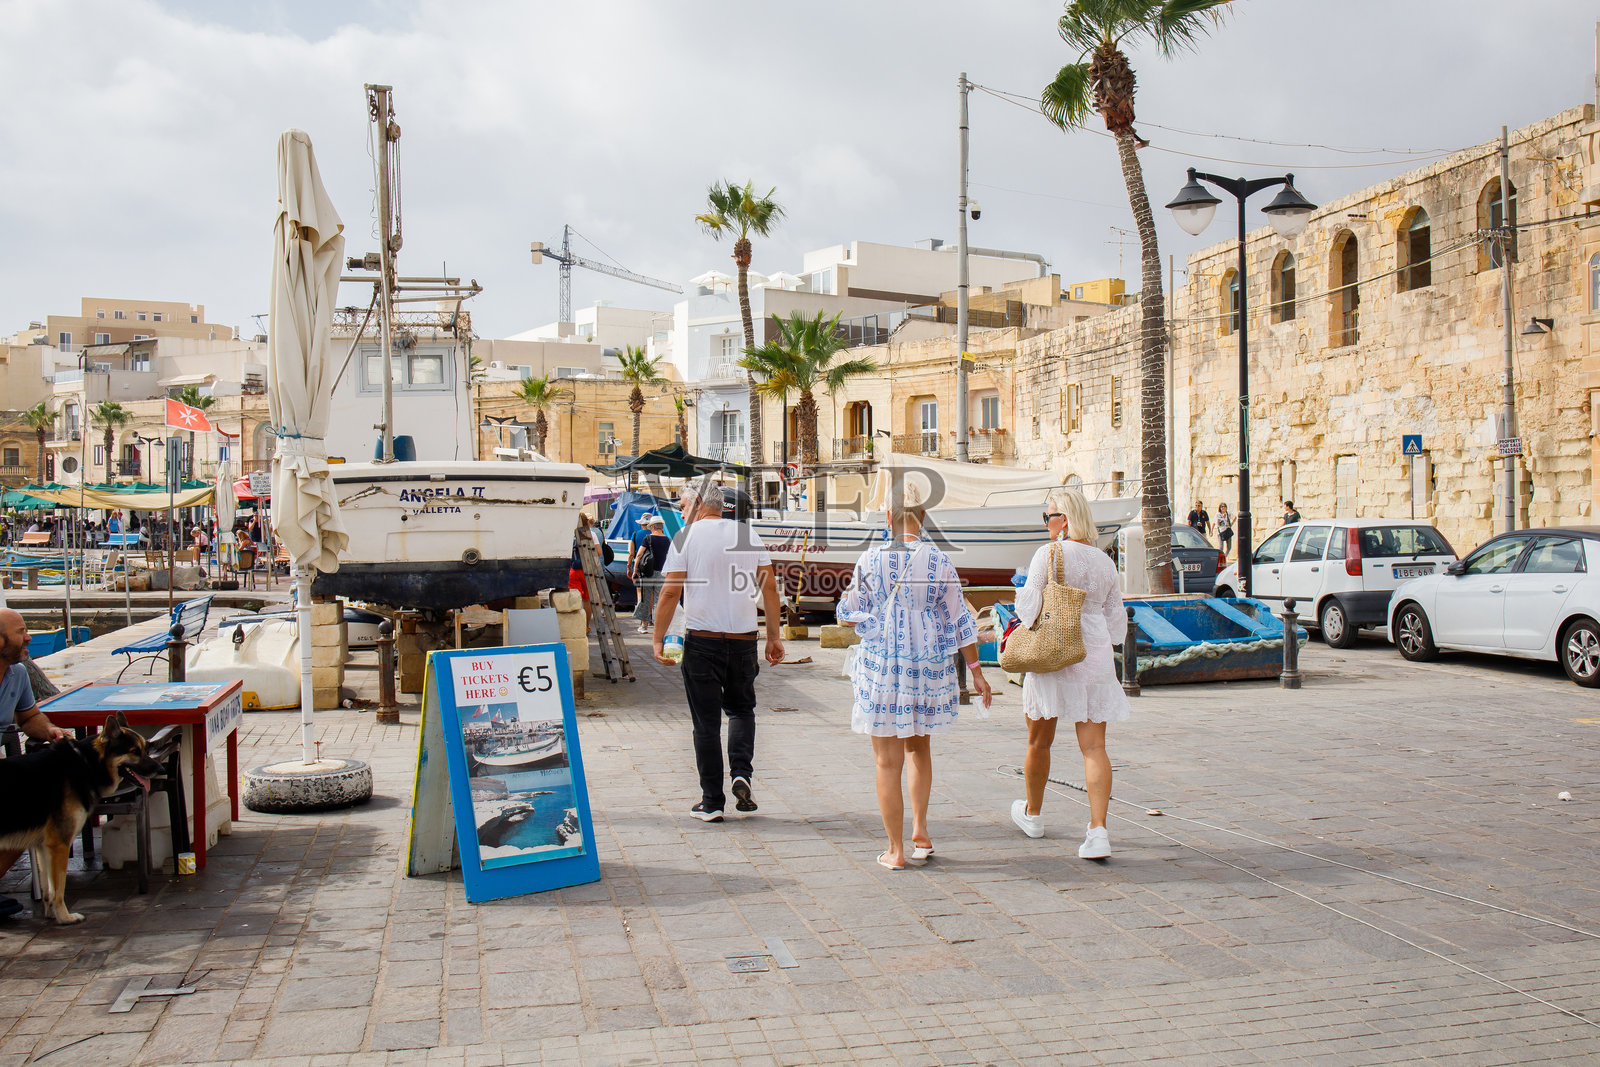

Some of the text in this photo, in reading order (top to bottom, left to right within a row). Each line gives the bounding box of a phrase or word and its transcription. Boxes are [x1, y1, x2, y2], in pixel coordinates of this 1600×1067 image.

[399, 487, 465, 502] ANGELA
[413, 506, 462, 515] VALLETTA
[764, 543, 828, 554] SCORPON
[471, 660, 494, 672] BUY
[461, 673, 510, 686] TICKETS
[517, 665, 553, 693] €5
[465, 688, 497, 700] HERE
